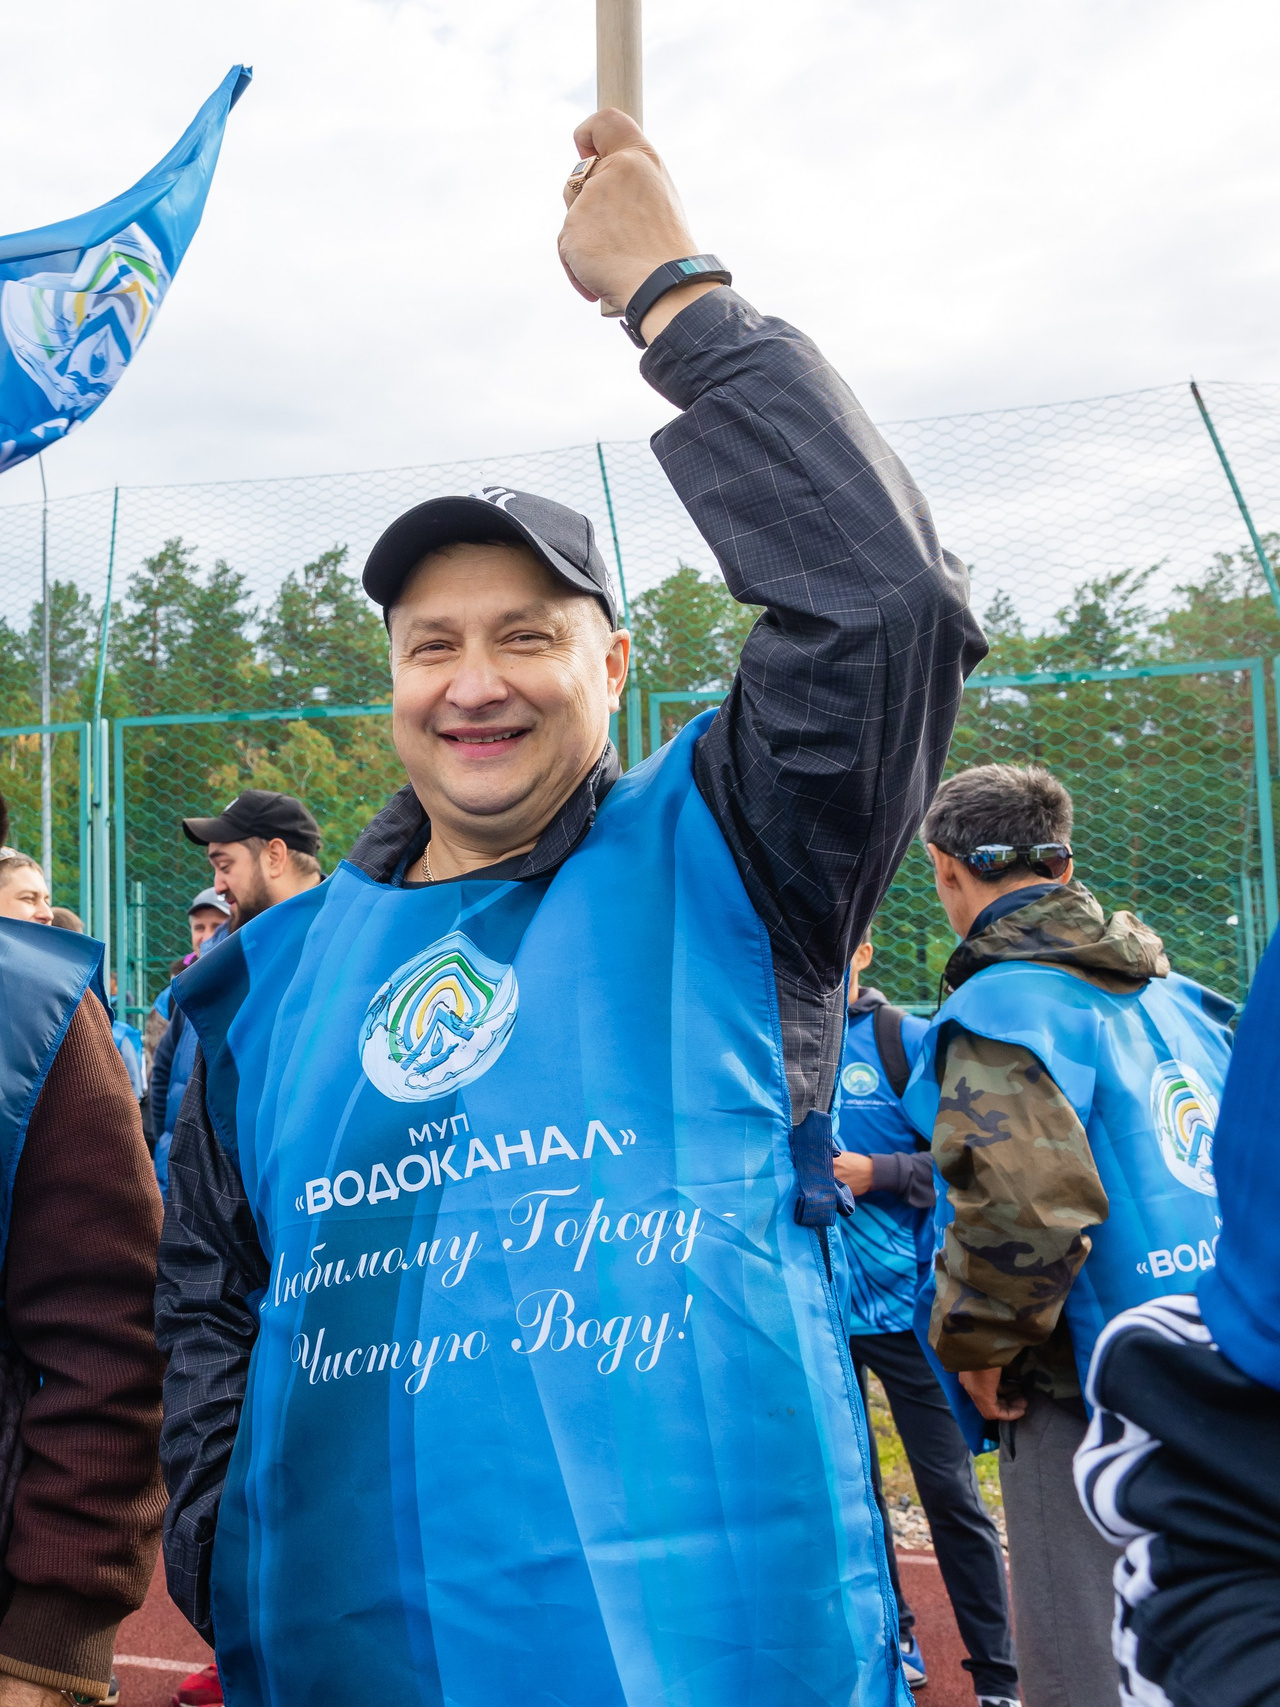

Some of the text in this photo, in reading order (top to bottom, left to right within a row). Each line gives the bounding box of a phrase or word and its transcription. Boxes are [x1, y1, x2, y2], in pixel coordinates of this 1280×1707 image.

[294, 1119, 637, 1216] «ВОДОКАНАЛ»
[408, 1112, 470, 1147] МУП
[502, 1184, 706, 1272] Городу
[1135, 1233, 1220, 1279] «ВОД
[289, 1288, 693, 1396] Чистую Воду!
